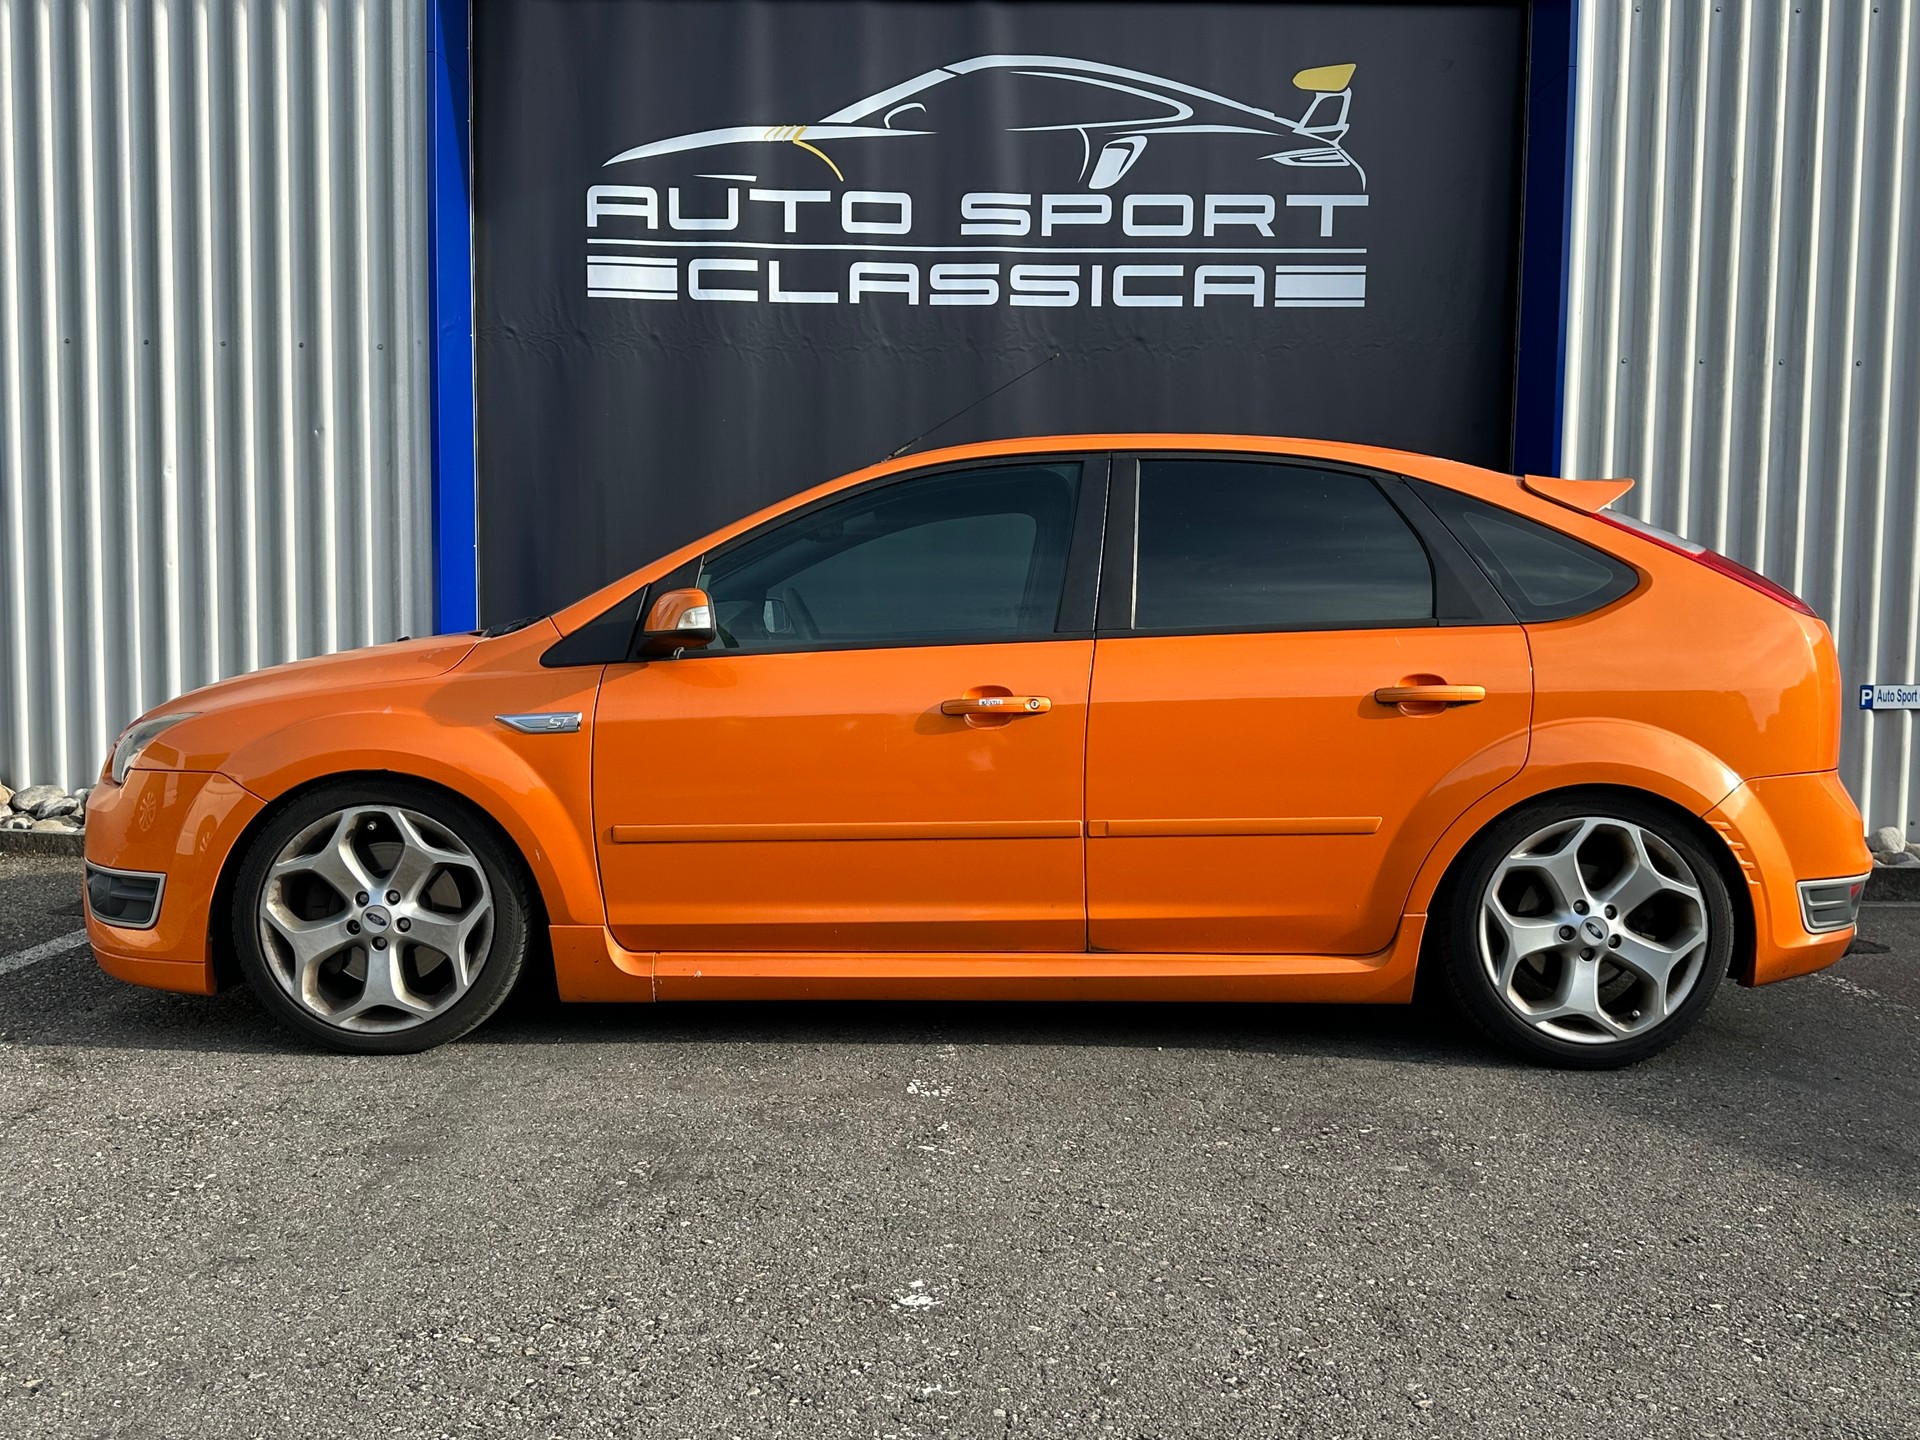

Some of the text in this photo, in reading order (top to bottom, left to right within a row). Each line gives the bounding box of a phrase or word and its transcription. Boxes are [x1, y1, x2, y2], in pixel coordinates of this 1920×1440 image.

[586, 185, 1370, 237] AUTO SPORT
[688, 258, 1265, 308] CLASSICA
[1861, 689, 1872, 706] P
[1876, 689, 1895, 702] Auto
[1896, 688, 1918, 706] Sport
